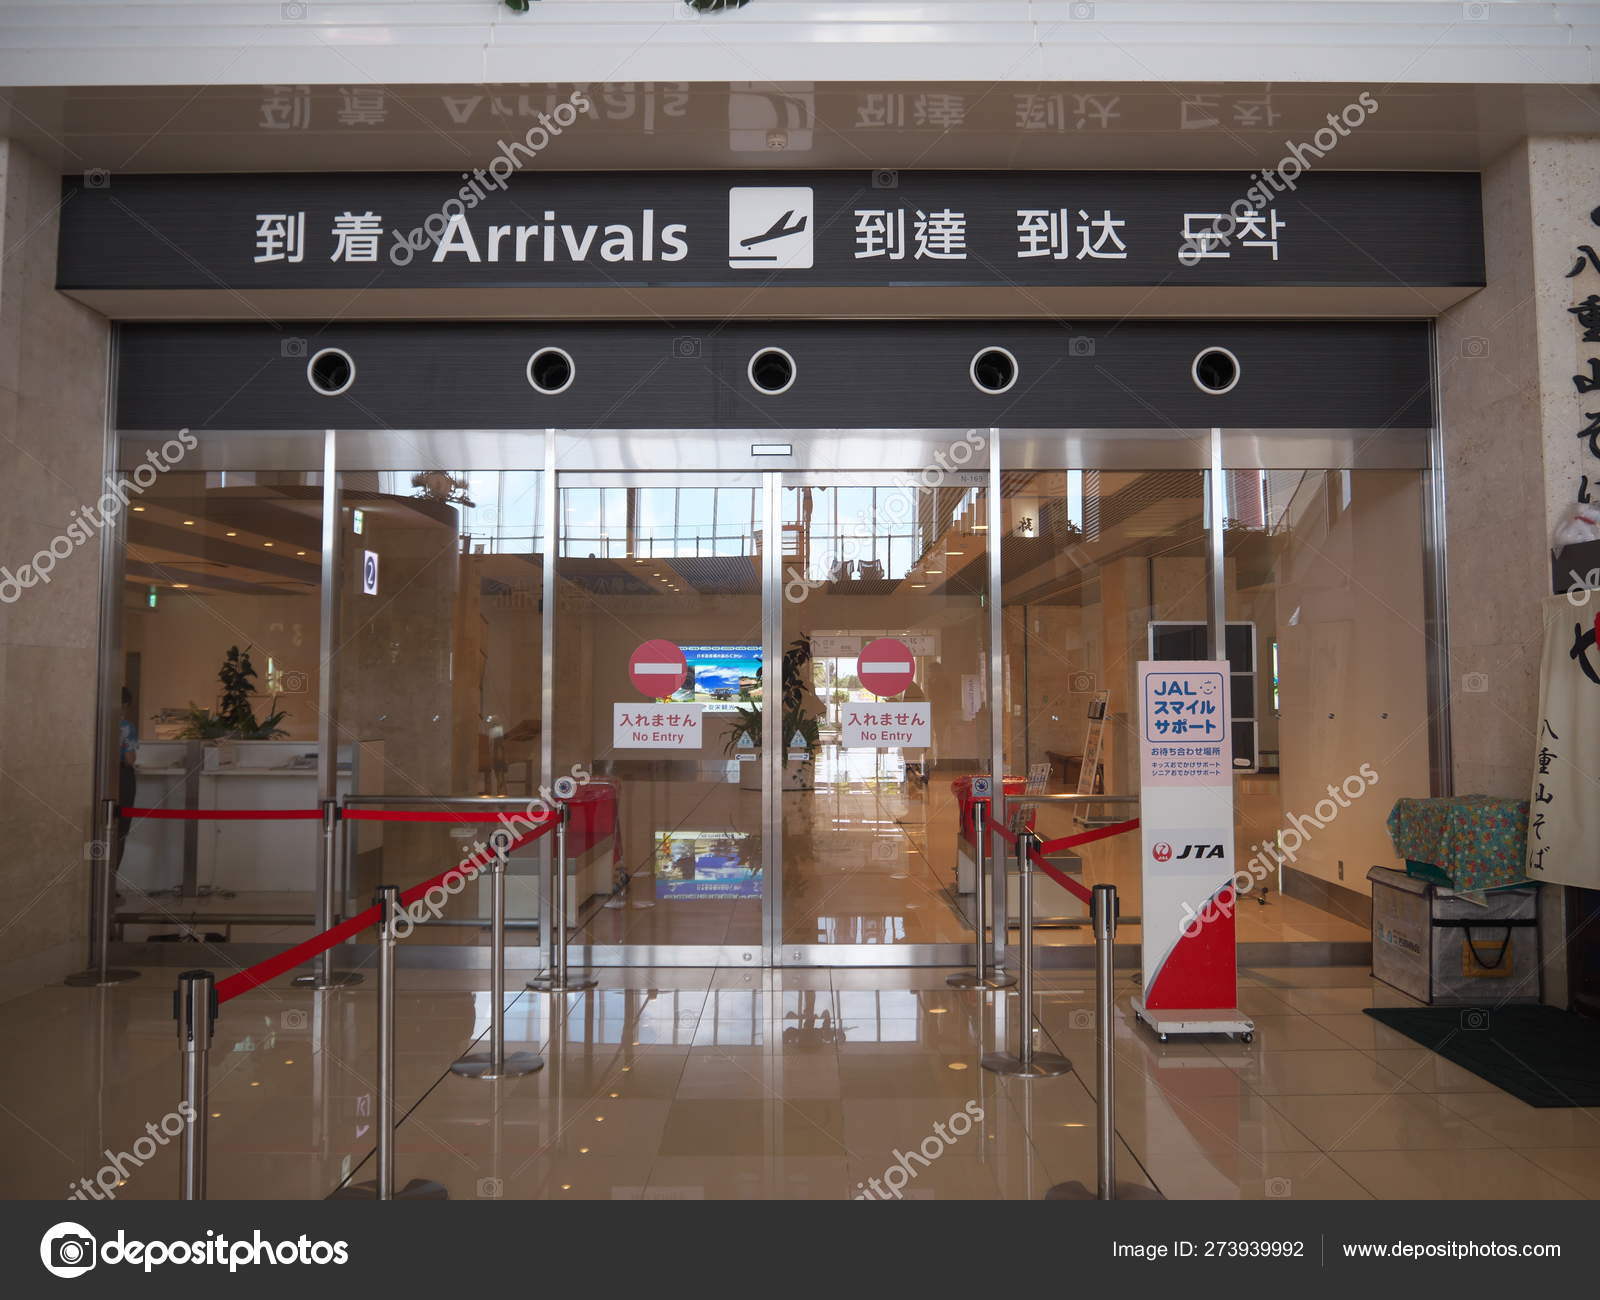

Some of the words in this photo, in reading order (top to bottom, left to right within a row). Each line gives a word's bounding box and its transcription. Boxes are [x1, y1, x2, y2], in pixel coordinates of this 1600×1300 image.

[432, 208, 689, 264] Arrivals
[854, 208, 968, 260] 到達
[1017, 208, 1127, 260] 到达
[1178, 208, 1286, 261] 도착
[1154, 680, 1197, 696] JAL
[1154, 700, 1216, 715] スマイル
[619, 713, 697, 728] 入れません
[848, 712, 925, 727] 入れません
[1155, 718, 1217, 734] サポート
[632, 731, 649, 742] No
[652, 731, 684, 744] Entry
[861, 730, 877, 741] No
[881, 730, 913, 743] Entry
[1151, 747, 1221, 757] お待ち合わせ場所
[1529, 718, 1559, 871] 八重山そば
[1176, 844, 1225, 859] JTA
